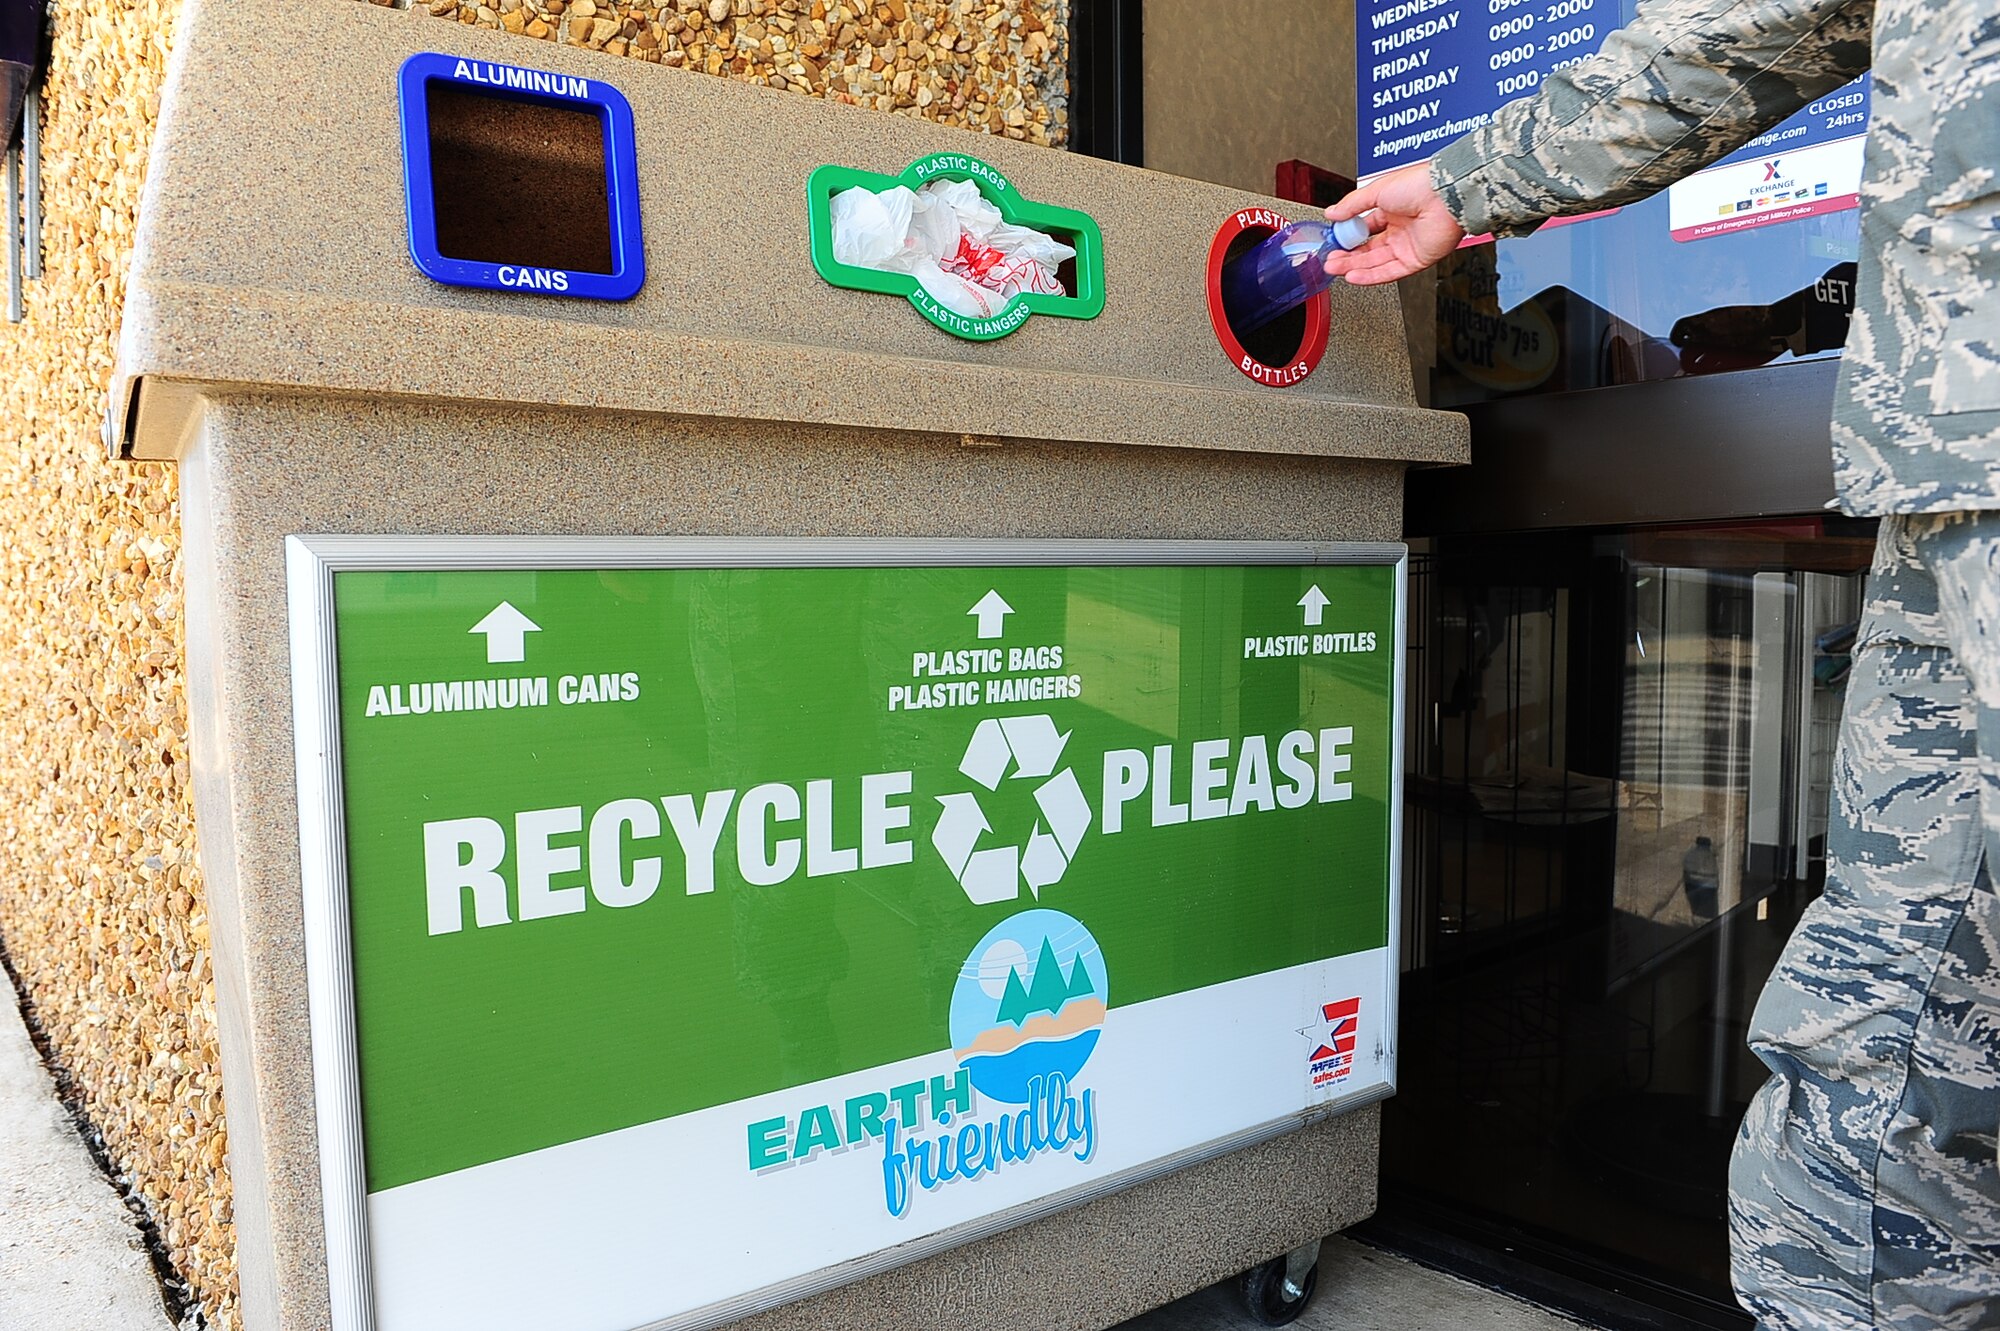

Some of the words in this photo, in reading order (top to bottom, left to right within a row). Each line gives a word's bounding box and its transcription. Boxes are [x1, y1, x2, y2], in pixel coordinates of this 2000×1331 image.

[1371, 0, 1453, 29] WEDNES
[1488, 0, 1530, 13] 09
[1371, 10, 1460, 55] THURSDAY
[1489, 14, 1534, 41] 0900
[1546, 0, 1594, 22] 2000
[1372, 48, 1431, 82] FRIDAY
[1489, 43, 1535, 71] 0900
[1547, 23, 1595, 52] 2000
[453, 60, 589, 99] ALUMINUM
[1372, 65, 1460, 108] SATURDAY
[1496, 70, 1539, 96] 1000
[1372, 99, 1441, 134] SUNDAY
[1808, 92, 1864, 115] CLOSED
[1825, 111, 1864, 129] 24hrs
[915, 156, 967, 179] PLASTIC
[970, 160, 1007, 191] BAGS
[1749, 180, 1795, 195] EXCHANGE
[1701, 224, 1716, 233] Case
[1723, 217, 1757, 229] Emergency
[1757, 213, 1769, 222] Call
[497, 265, 569, 291] CANS
[1814, 277, 1850, 305] GET
[912, 288, 970, 333] PLASTIC
[973, 302, 1029, 335] HANGERS
[1453, 325, 1495, 368] Cut
[1241, 354, 1308, 384] BOTTLES
[913, 648, 1002, 677] PLASTIC
[1008, 645, 1063, 672] BAGS
[1244, 635, 1309, 659] PLASTIC
[1312, 631, 1377, 655] BOTTLES
[365, 676, 548, 717] ALUMINUM
[557, 672, 640, 705] CANS
[888, 681, 979, 711] PLASTIC
[985, 674, 1082, 704] HANGERS
[423, 769, 915, 937] RECYCLE
[1102, 725, 1355, 836] PLEASE
[1312, 1066, 1351, 1084] aafes.com
[747, 1068, 971, 1171] EARTH
[882, 1071, 1094, 1218] friendly
